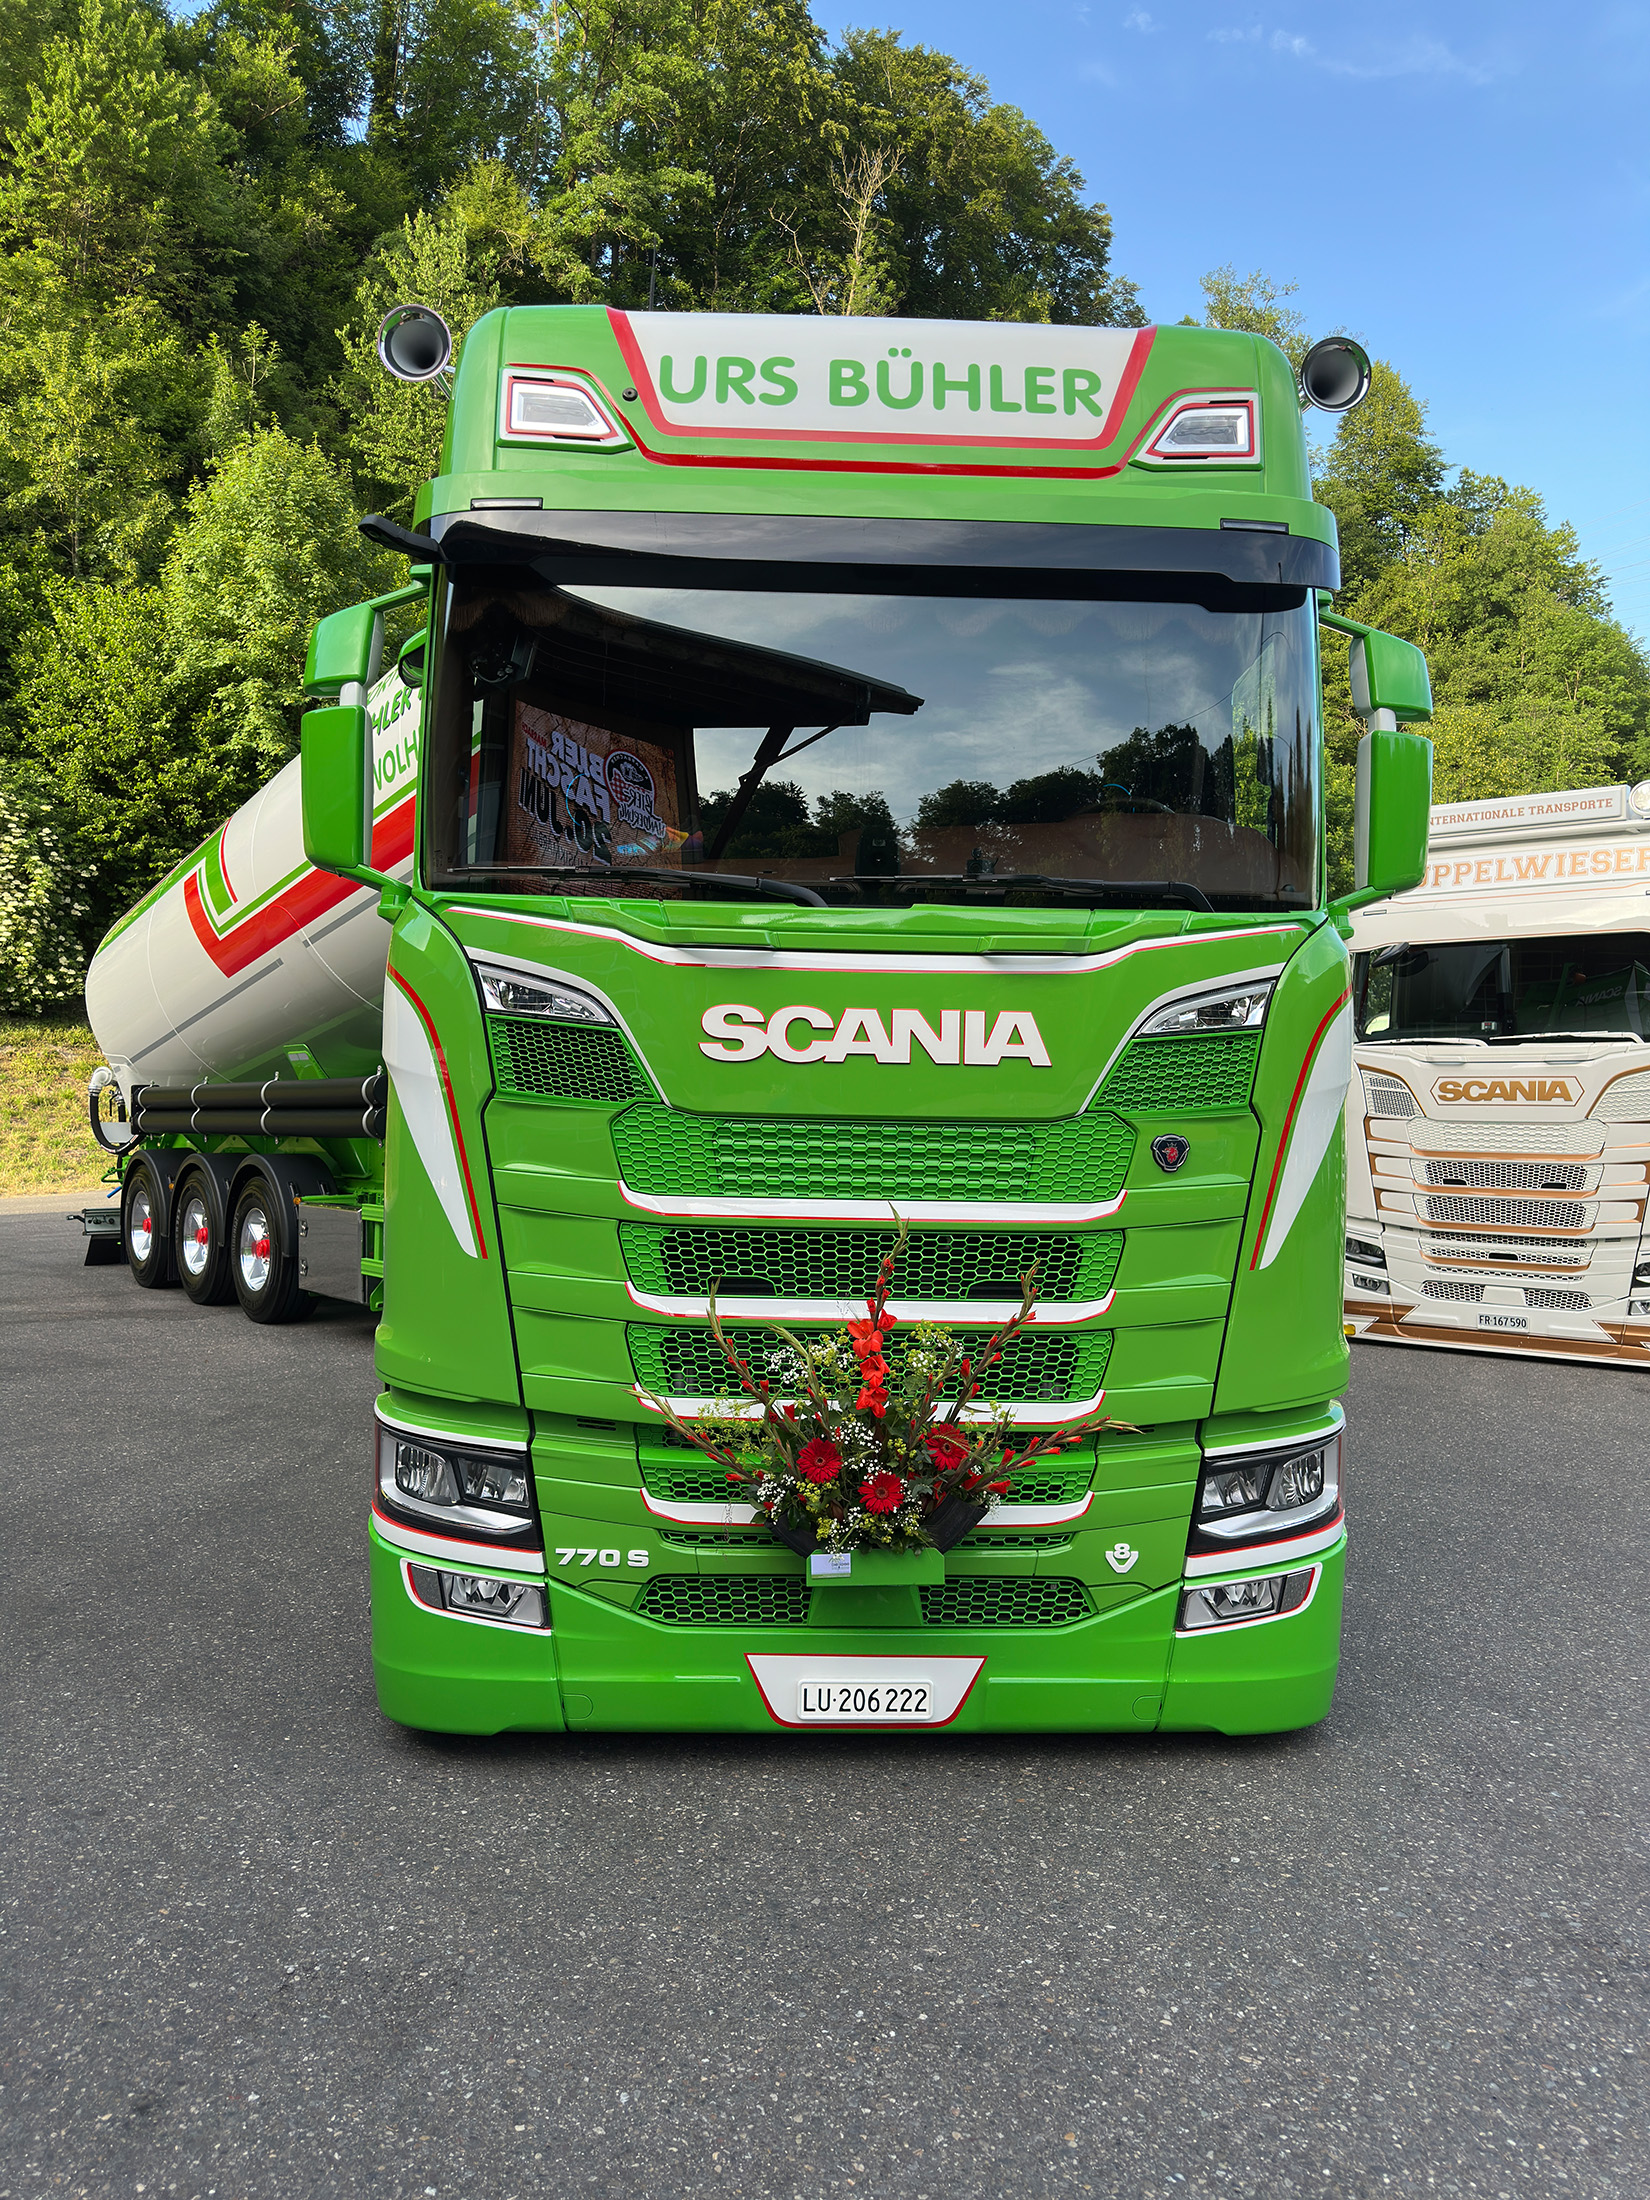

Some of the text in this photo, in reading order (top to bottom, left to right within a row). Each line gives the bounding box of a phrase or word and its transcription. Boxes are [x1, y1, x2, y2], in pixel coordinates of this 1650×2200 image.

[659, 347, 1104, 418] URS BÜHLER
[1528, 798, 1613, 816] TRANSPORTE
[698, 1004, 1053, 1067] SCANIA
[1437, 1080, 1573, 1102] SCANIA
[555, 1547, 650, 1568] 770 S
